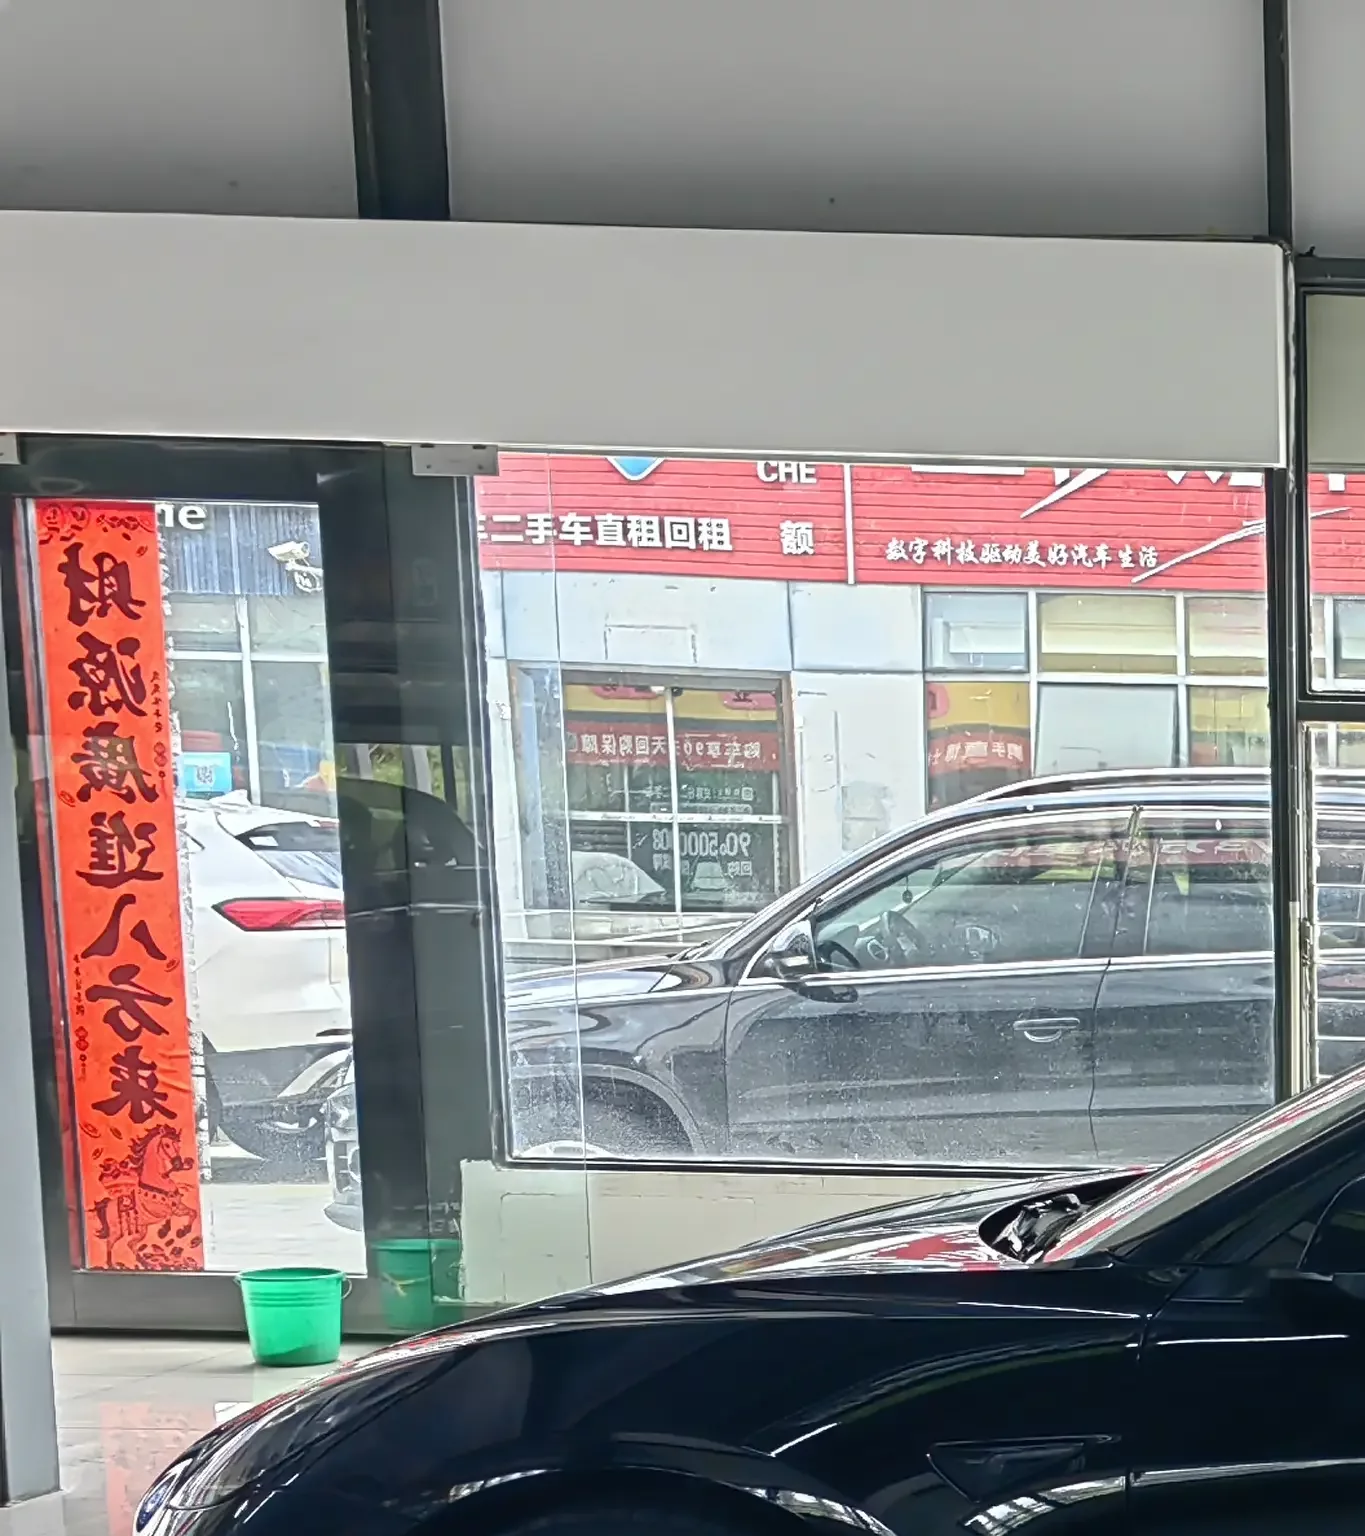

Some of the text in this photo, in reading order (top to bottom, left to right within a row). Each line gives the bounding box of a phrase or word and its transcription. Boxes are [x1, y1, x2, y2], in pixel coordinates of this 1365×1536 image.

[477, 512, 815, 556] 二手车直租回租 额
[885, 538, 1159, 570] 数字科技驱动美好汽车生活
